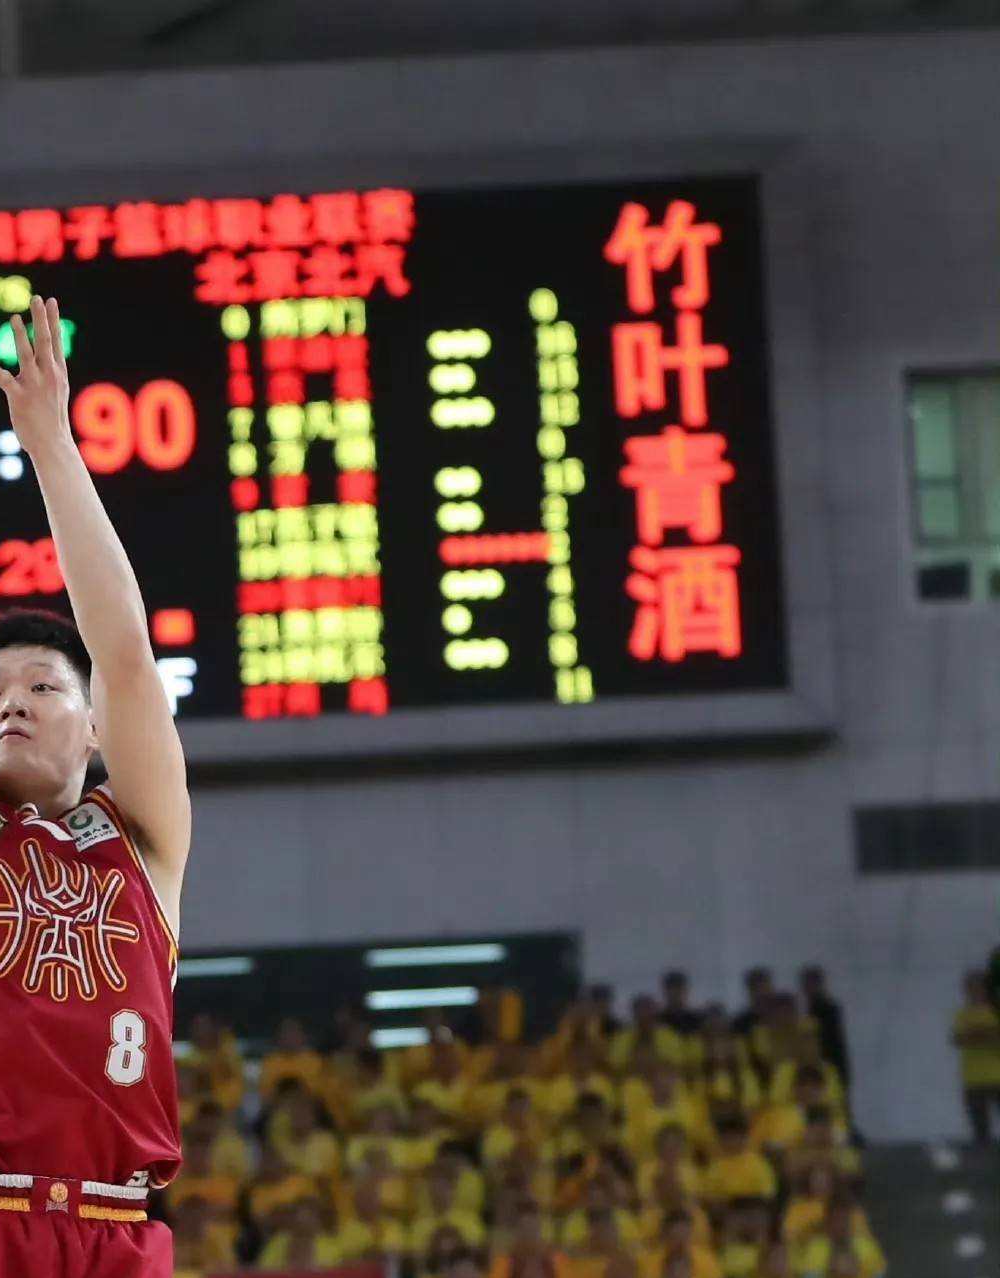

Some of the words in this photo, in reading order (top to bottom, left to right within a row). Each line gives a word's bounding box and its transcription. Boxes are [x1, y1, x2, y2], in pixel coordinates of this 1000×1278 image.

[73, 379, 196, 474] 90
[604, 200, 741, 661] 竹叶青酒
[104, 1008, 147, 1087] 8
